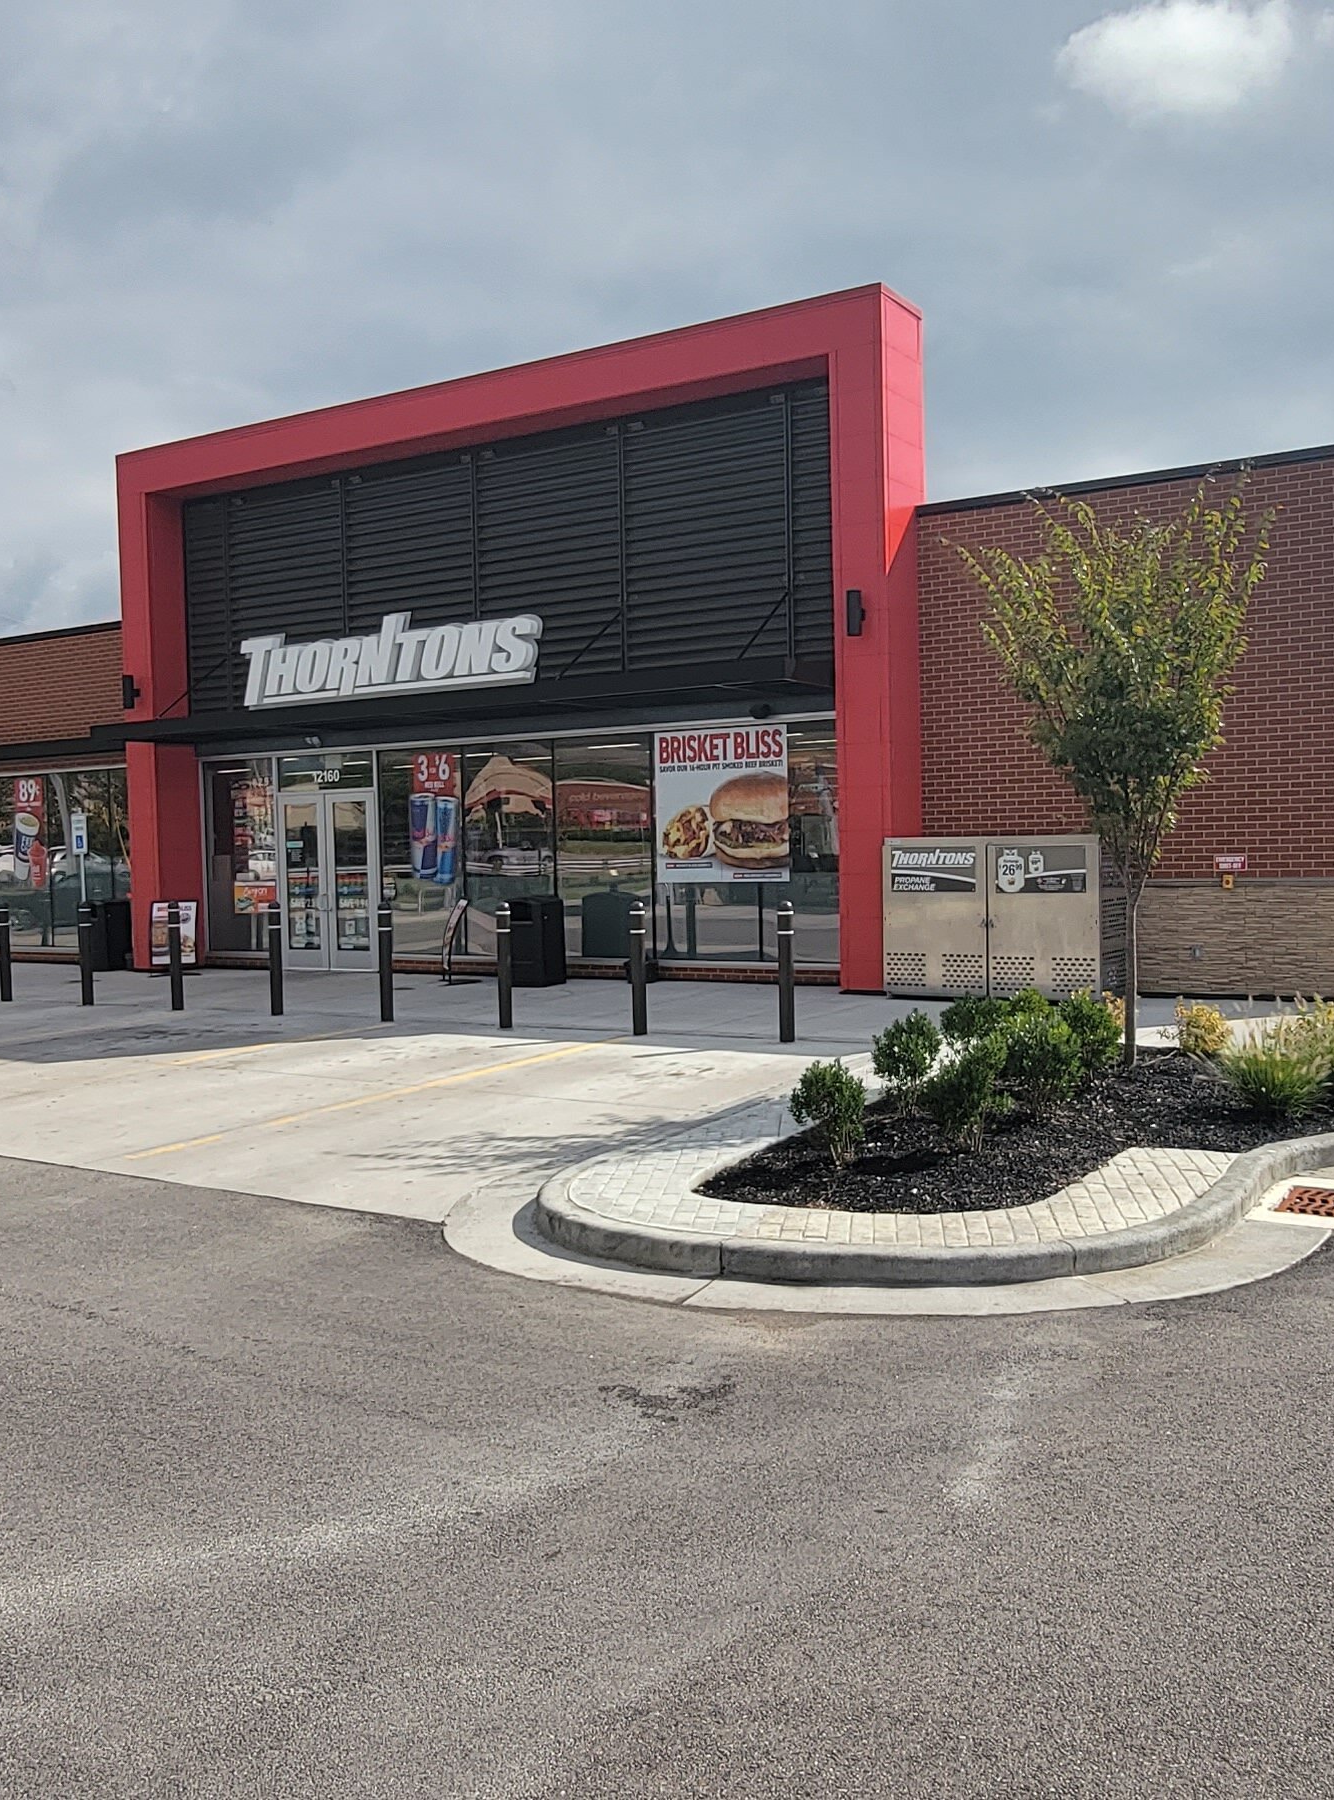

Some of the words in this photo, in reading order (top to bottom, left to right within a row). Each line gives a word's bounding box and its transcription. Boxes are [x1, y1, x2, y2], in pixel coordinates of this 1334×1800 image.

[240, 611, 542, 711] THORNTONS
[659, 733, 730, 764] BRISKET
[733, 729, 783, 760] BLISS
[313, 769, 340, 783] 12160
[417, 755, 428, 781] 3
[660, 765, 676, 773] SAVOR
[677, 764, 688, 772] OUR
[712, 762, 721, 770] PIT
[722, 761, 744, 770] SMOKED
[745, 760, 757, 768] BEEF
[892, 849, 976, 868] THORNTONS
[894, 876, 931, 884] PROPANE
